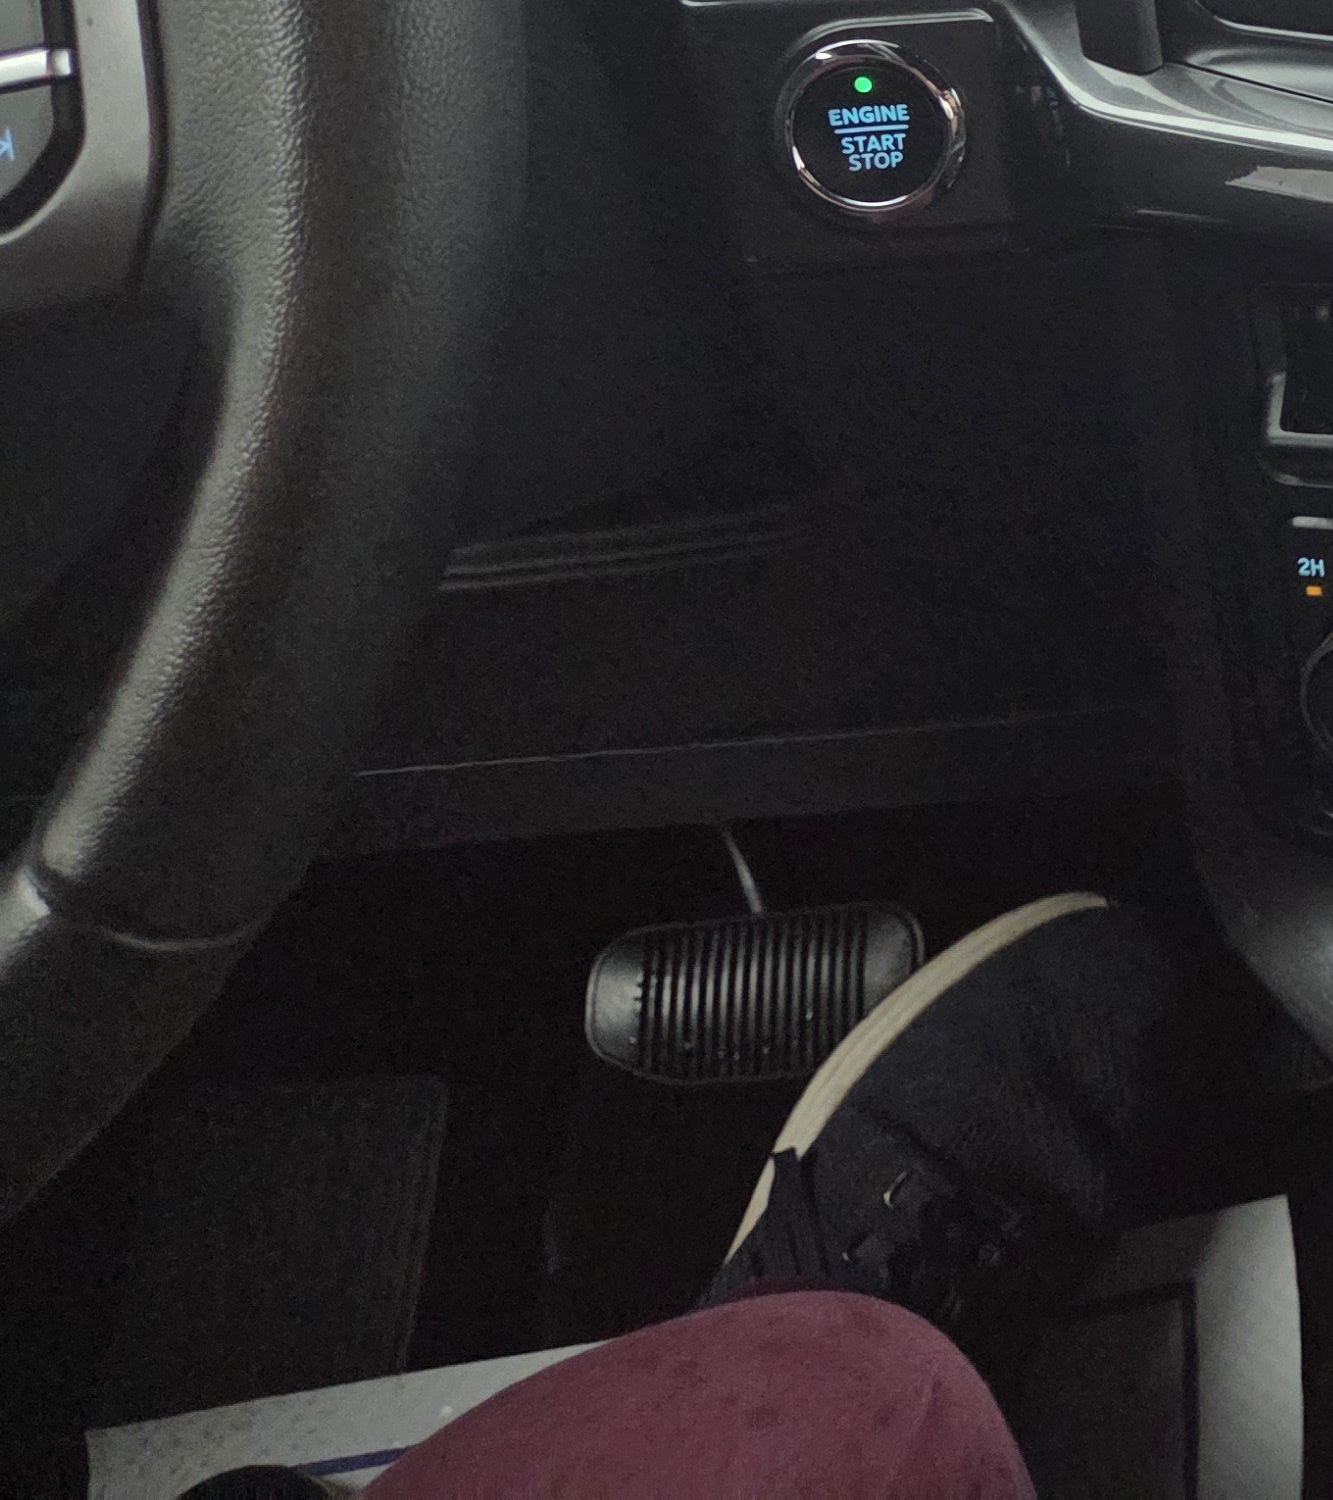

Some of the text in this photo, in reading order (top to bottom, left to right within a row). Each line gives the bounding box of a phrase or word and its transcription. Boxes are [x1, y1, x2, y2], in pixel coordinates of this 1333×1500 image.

[828, 104, 909, 126] ENGINE
[841, 133, 906, 154] START
[849, 152, 904, 172] STOP
[1297, 557, 1325, 578] 2H
